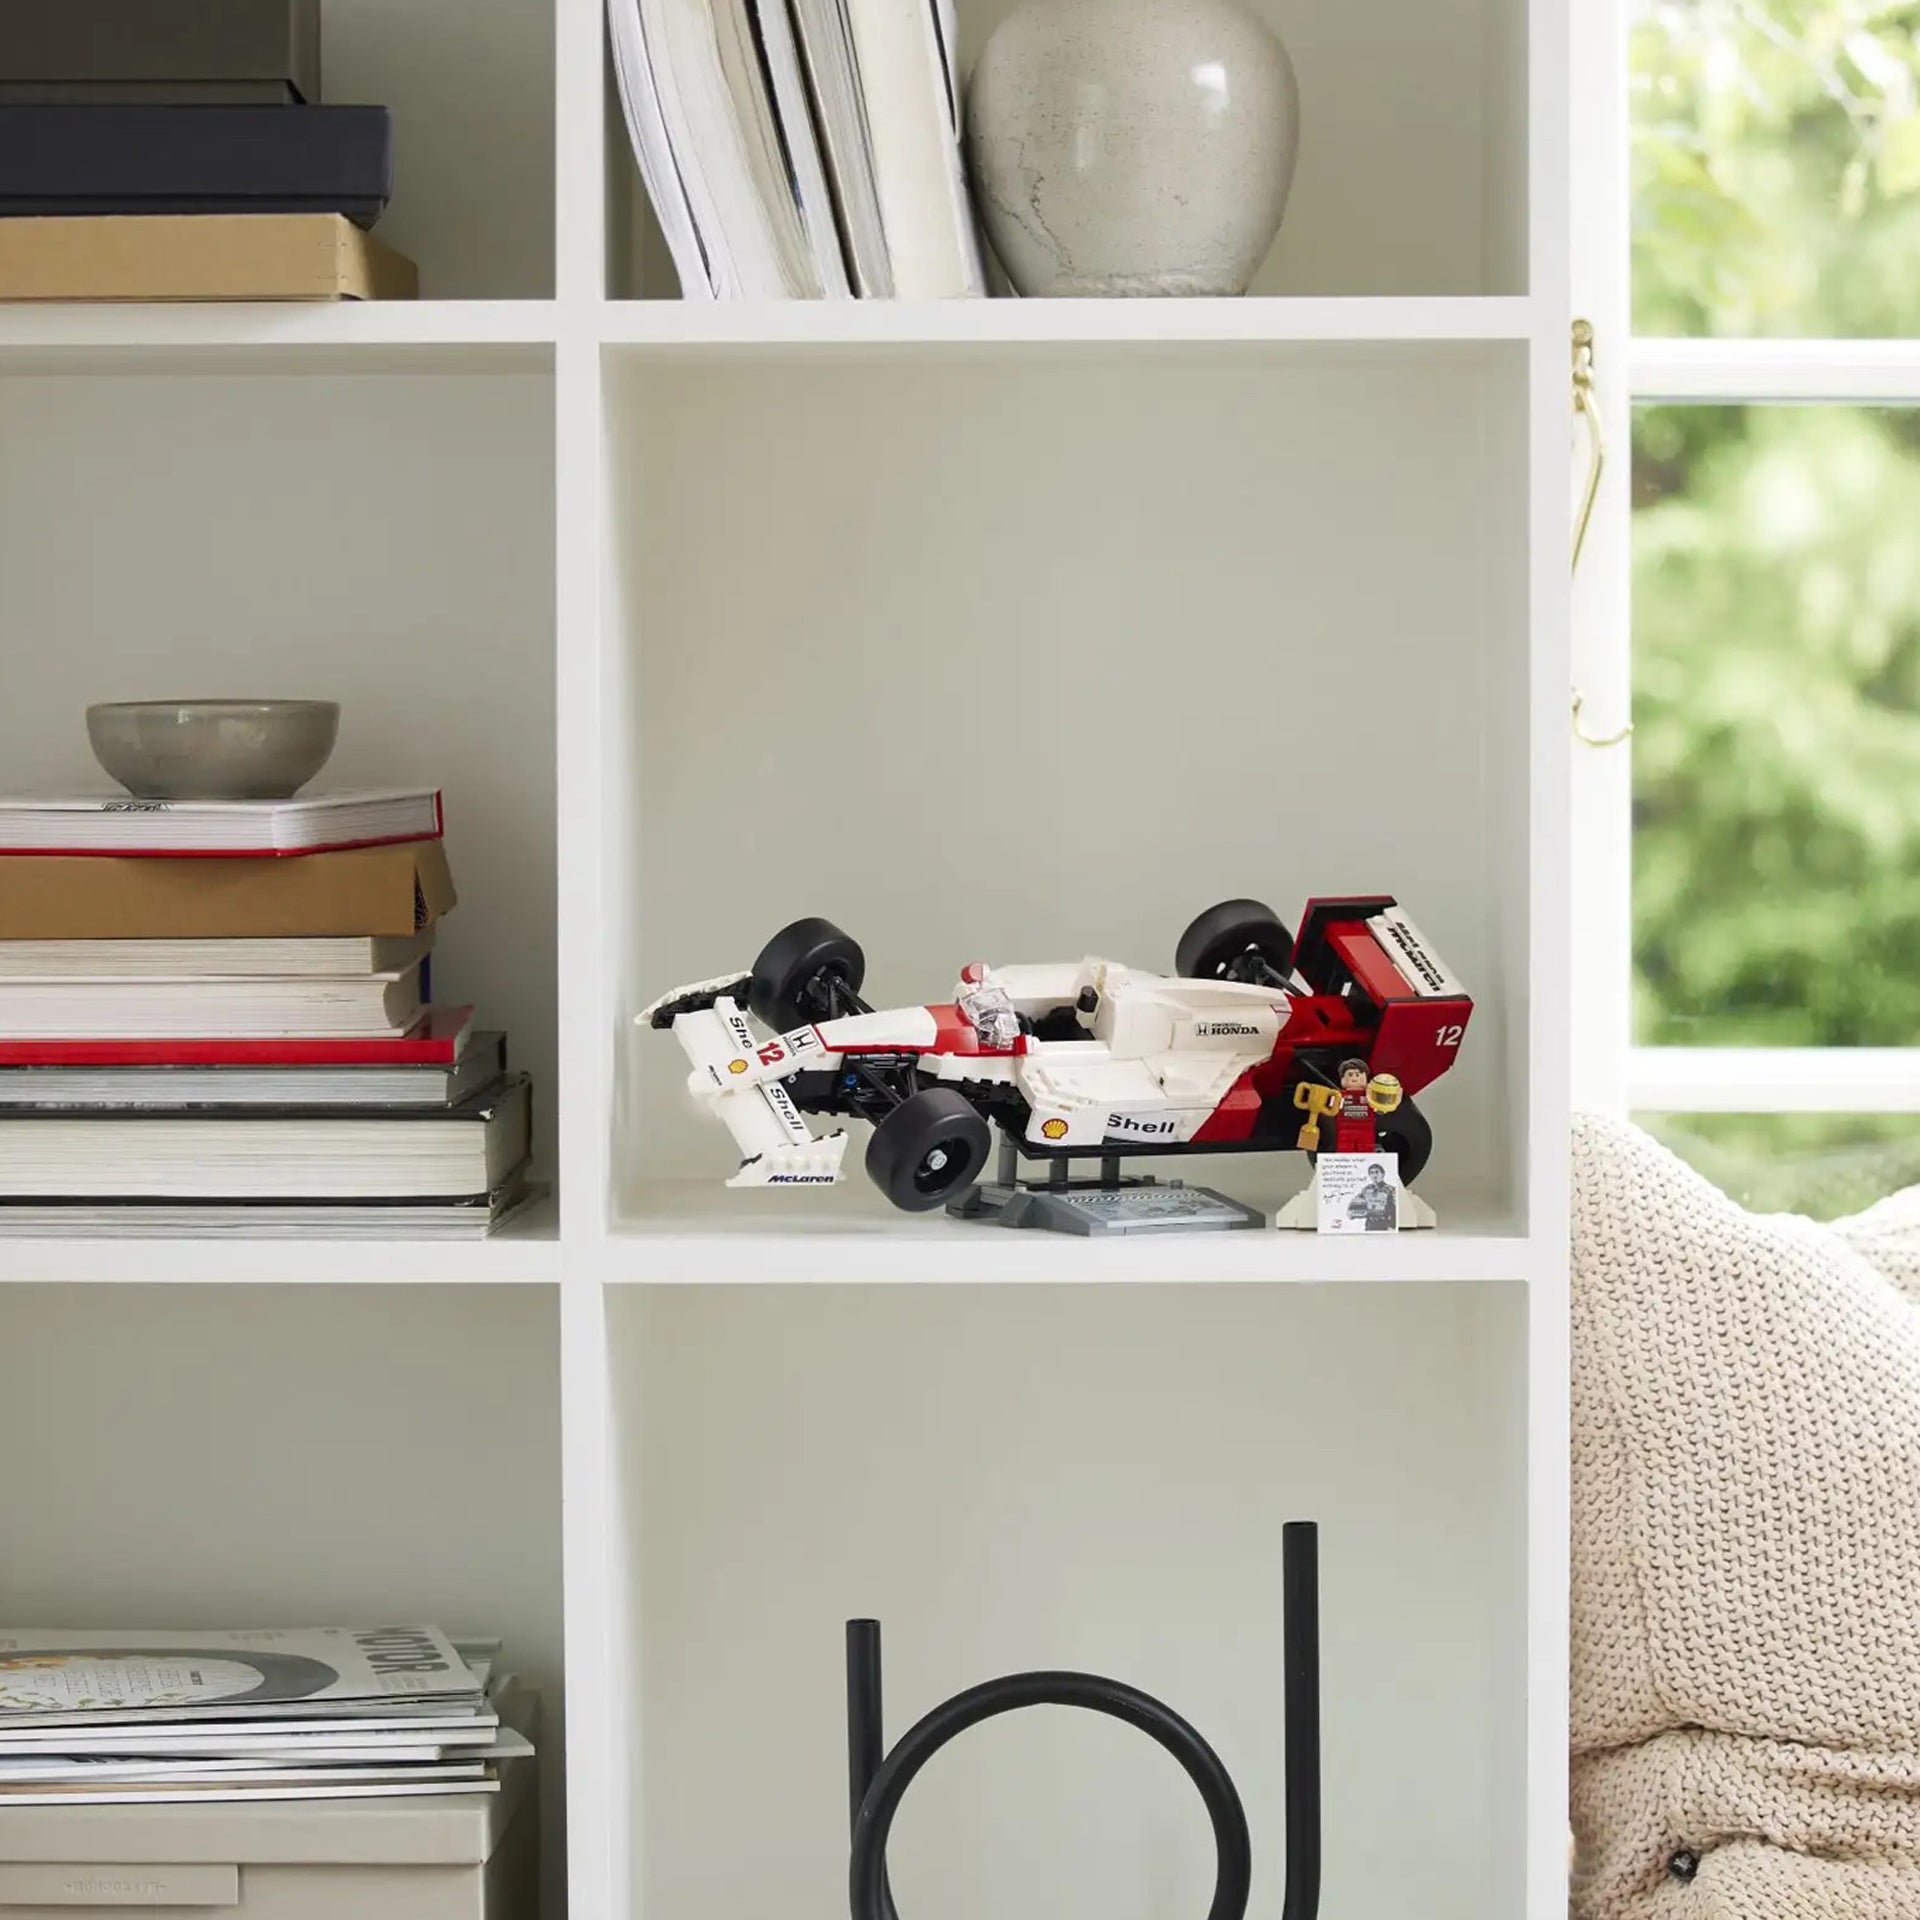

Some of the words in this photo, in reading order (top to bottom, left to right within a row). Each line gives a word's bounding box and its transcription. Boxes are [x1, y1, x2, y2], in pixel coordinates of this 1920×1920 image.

[729, 1016, 753, 1049] She
[1211, 1026, 1259, 1035] HONDA
[1436, 1025, 1462, 1046] 12
[756, 1042, 785, 1066] 12
[771, 1088, 804, 1130] Shell
[1107, 1113, 1175, 1133] Shell
[767, 1175, 834, 1183] McLaren
